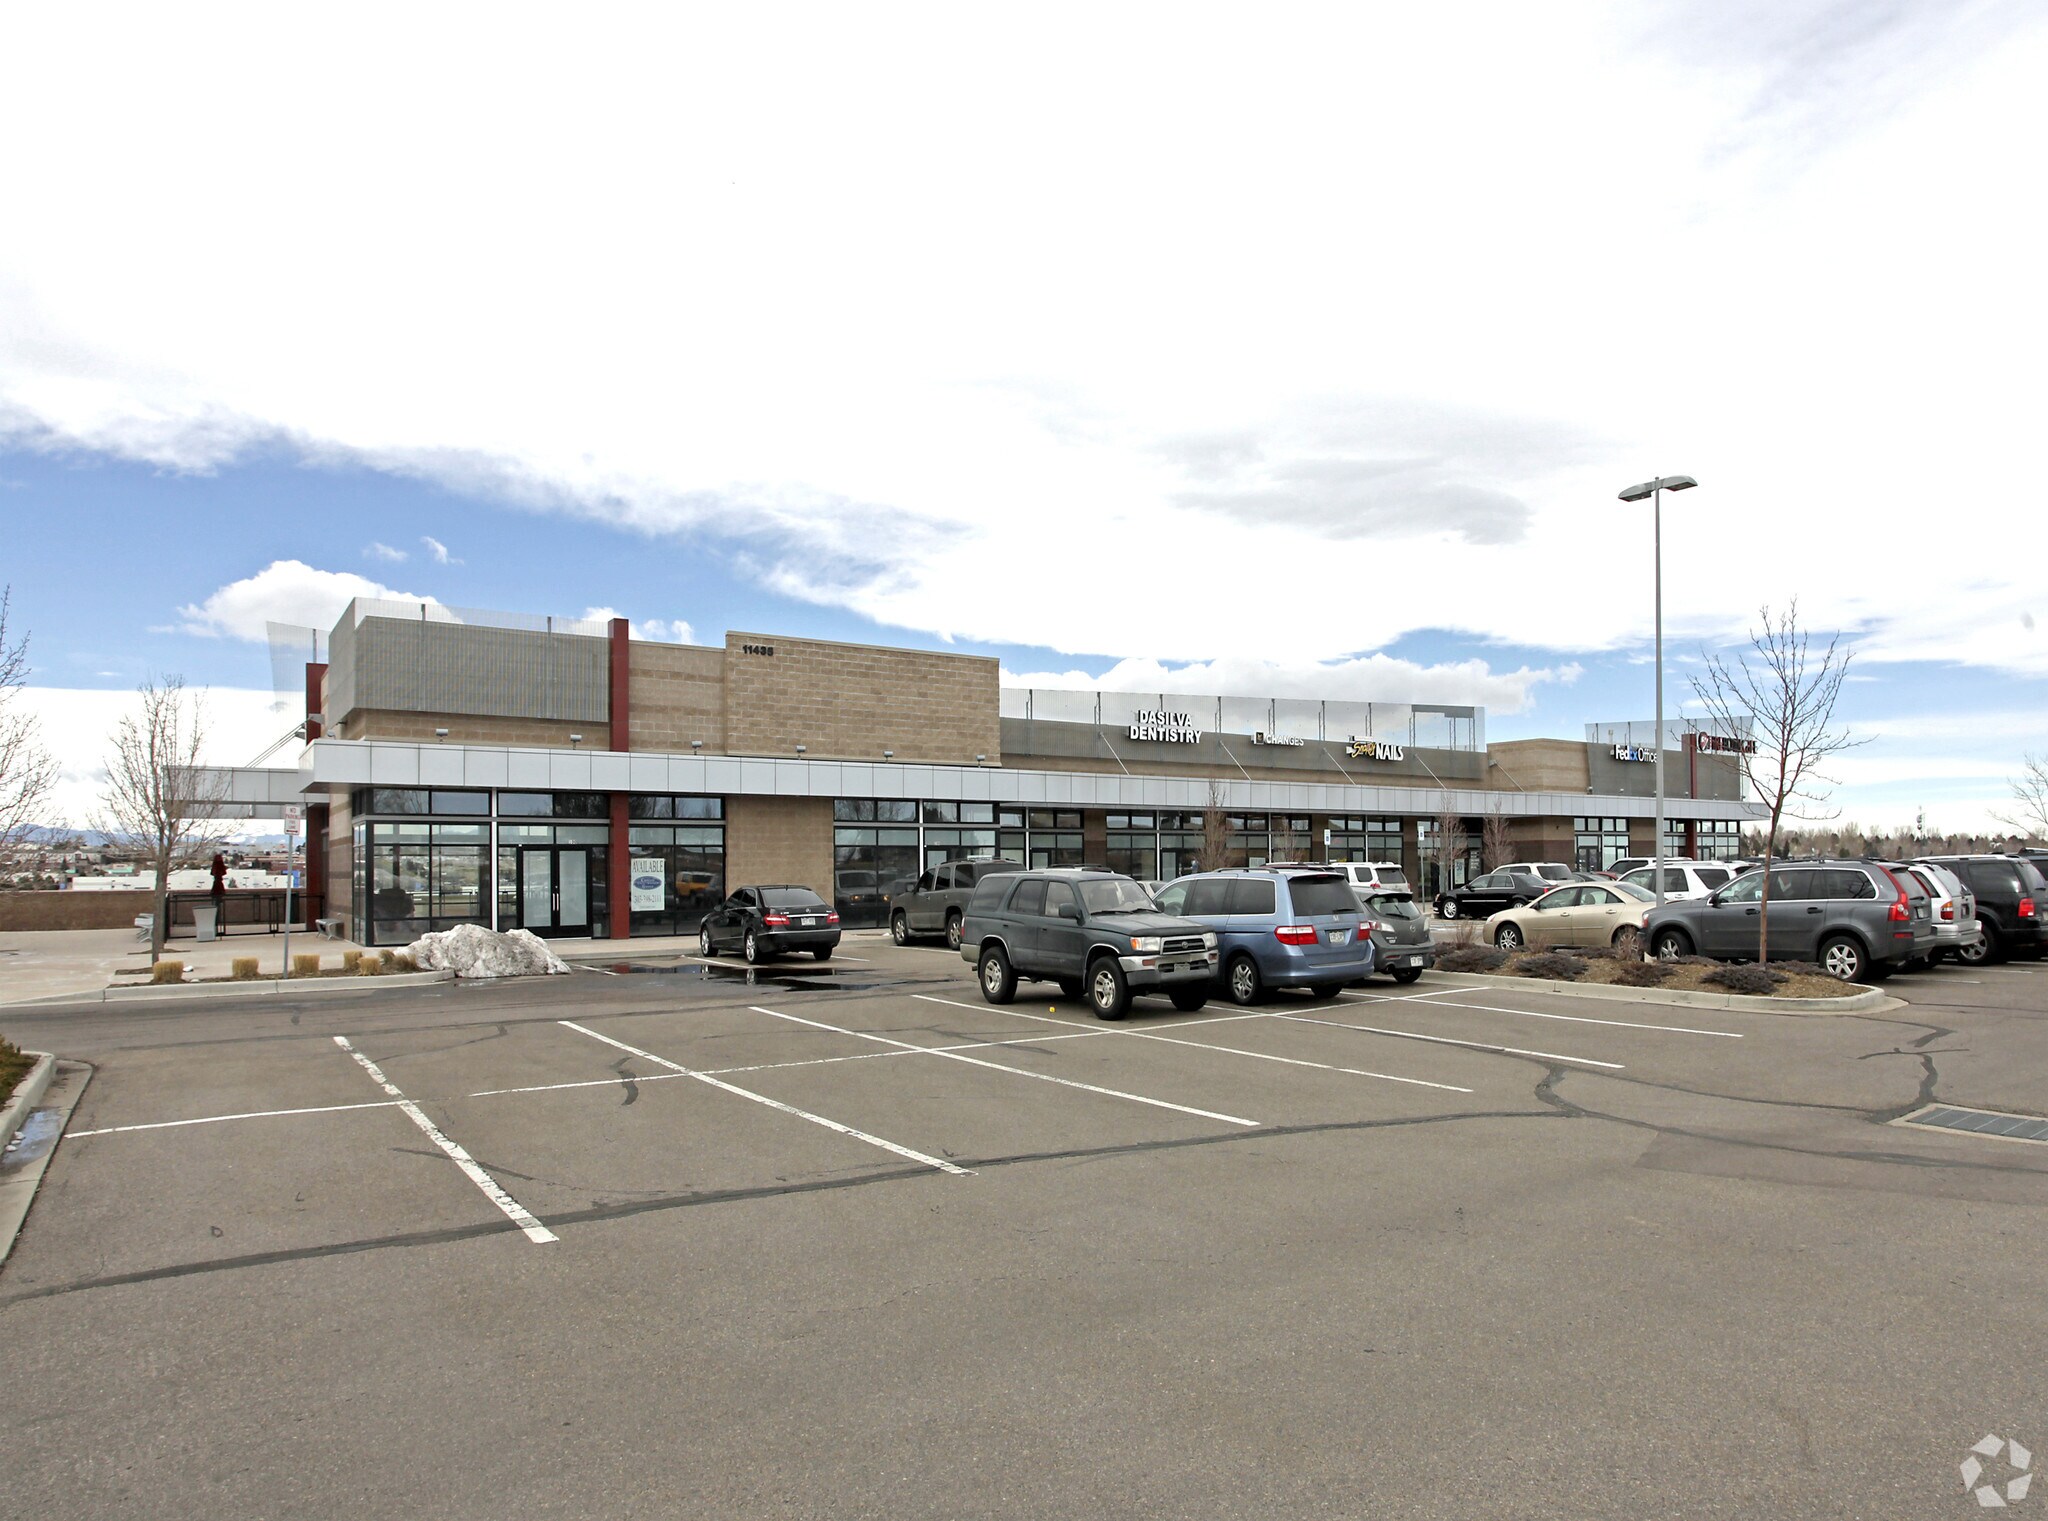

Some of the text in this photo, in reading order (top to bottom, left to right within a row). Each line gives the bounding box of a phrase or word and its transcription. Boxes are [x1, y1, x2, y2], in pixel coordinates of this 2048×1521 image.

[1138, 709, 1193, 727] DASILVA
[1129, 725, 1202, 744] DENTISTRY
[1266, 734, 1305, 747] CHANGES
[1375, 742, 1404, 761] NAILS
[1614, 744, 1657, 763] FedEx Office
[633, 860, 663, 873] AVAILABLE
